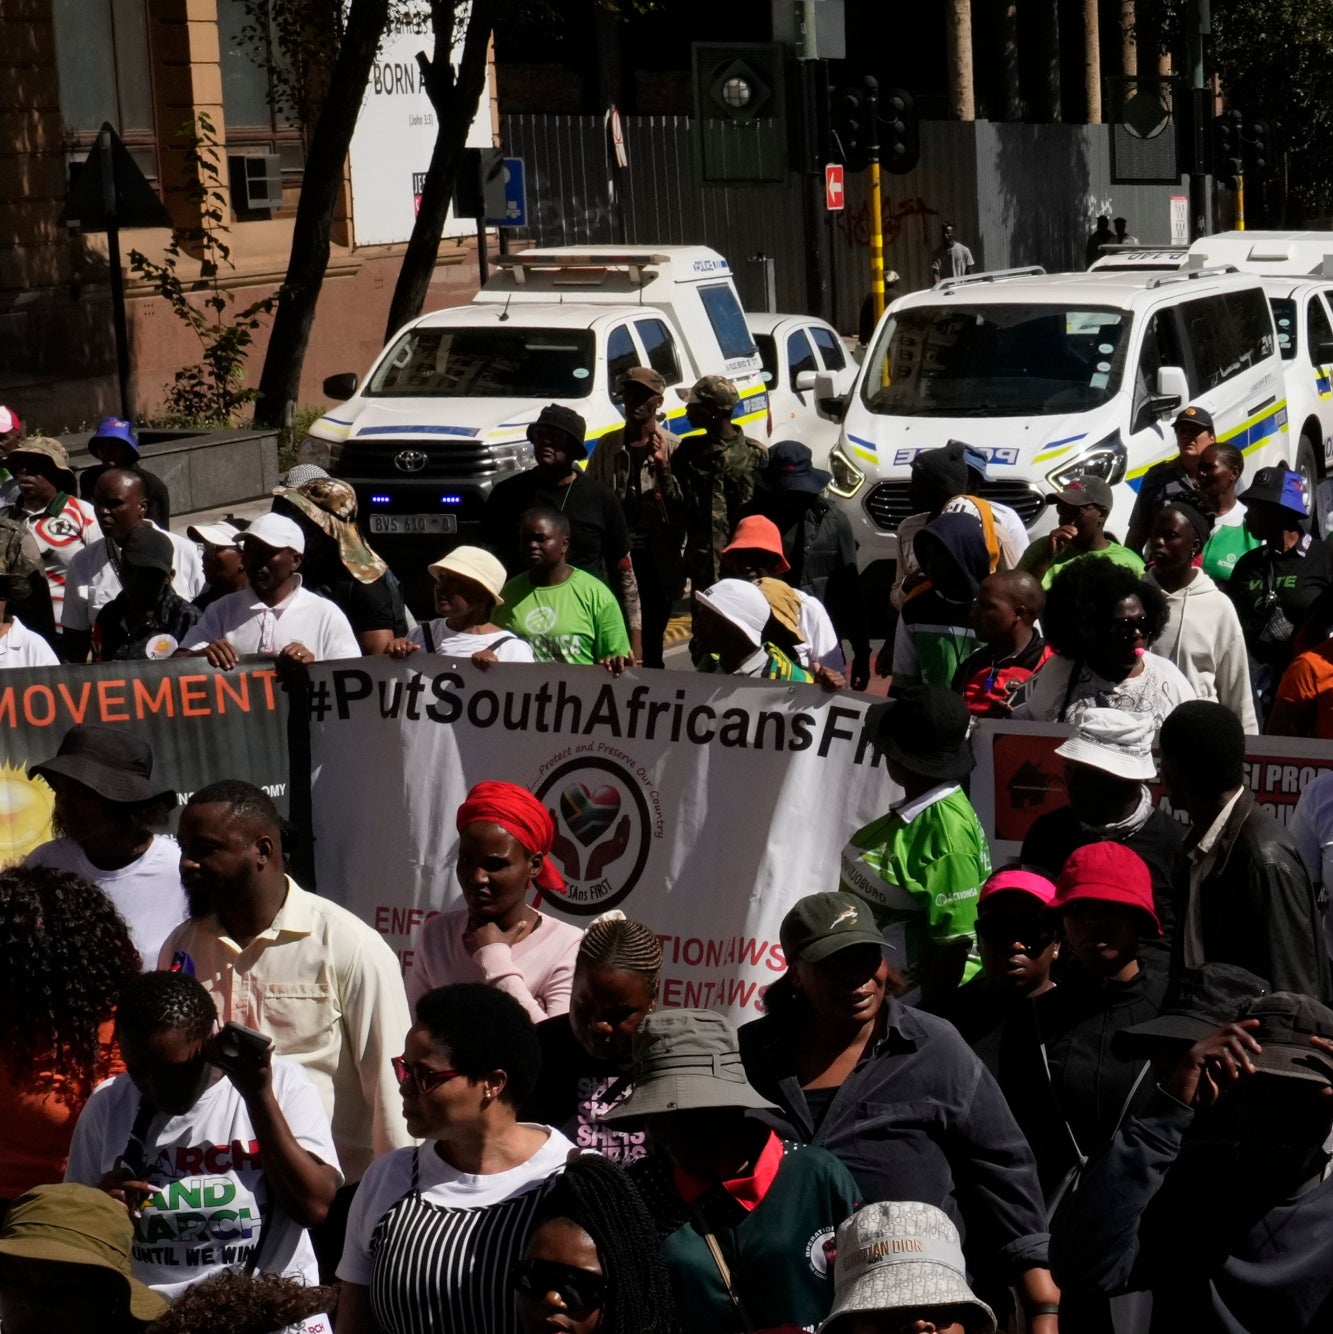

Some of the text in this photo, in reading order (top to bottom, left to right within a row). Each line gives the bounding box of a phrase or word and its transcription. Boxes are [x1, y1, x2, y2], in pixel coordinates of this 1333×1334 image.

[373, 62, 415, 95] BORN
[539, 747, 573, 776] Protect
[575, 742, 595, 753] and
[597, 742, 637, 771] Preserve
[649, 789, 665, 840] Country
[589, 878, 613, 900] FIRST
[185, 1247, 213, 1267] WE
[891, 1239, 923, 1254] DIOR
